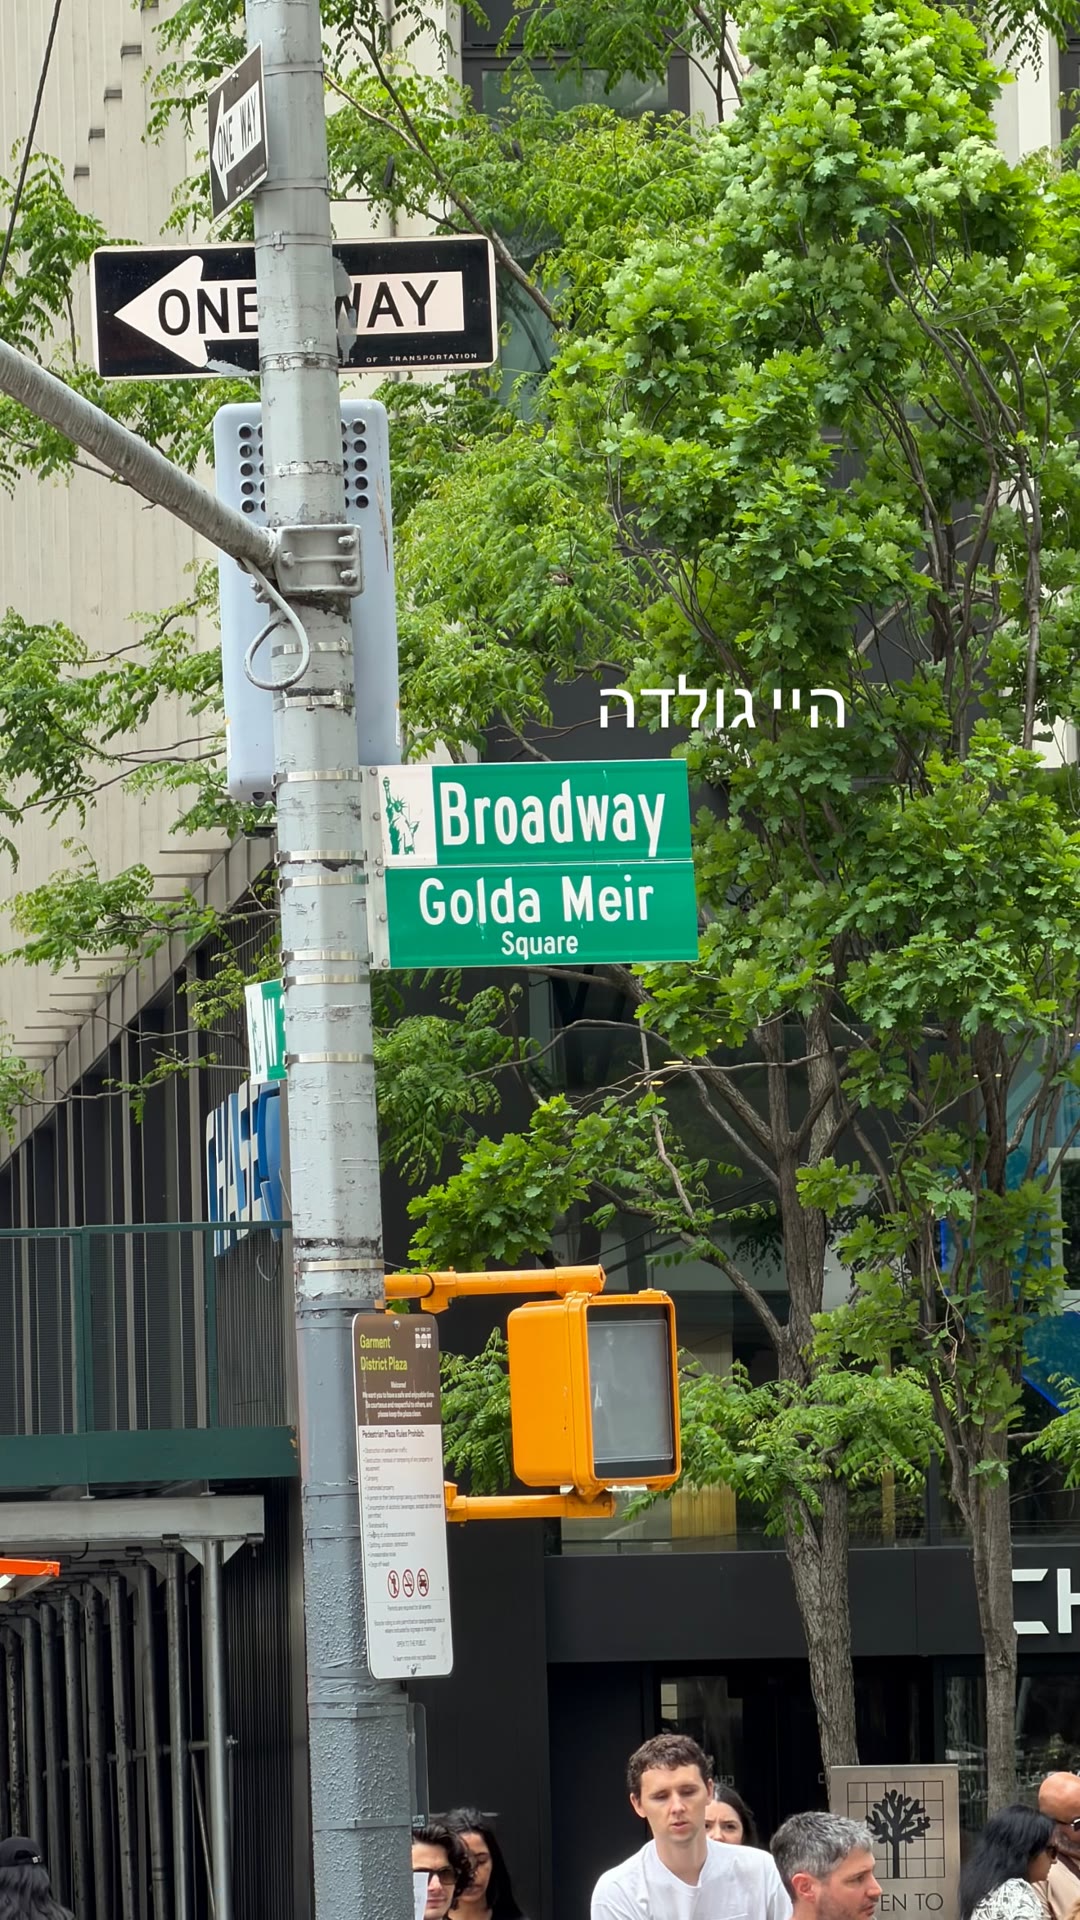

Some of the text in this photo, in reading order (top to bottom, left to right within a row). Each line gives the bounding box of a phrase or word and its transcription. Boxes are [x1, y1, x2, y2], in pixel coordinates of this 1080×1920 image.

[217, 92, 258, 171] ONE WAY
[158, 286, 259, 336] ONE
[389, 353, 478, 363] TRANSPORTATION
[440, 779, 666, 857] Broadway
[419, 874, 654, 925] Golda Meir
[501, 931, 579, 960] Square
[205, 1080, 268, 1257] CHASE
[360, 1334, 391, 1349] Garment
[360, 1356, 408, 1371] District Plaza
[914, 1892, 944, 1911] TO
